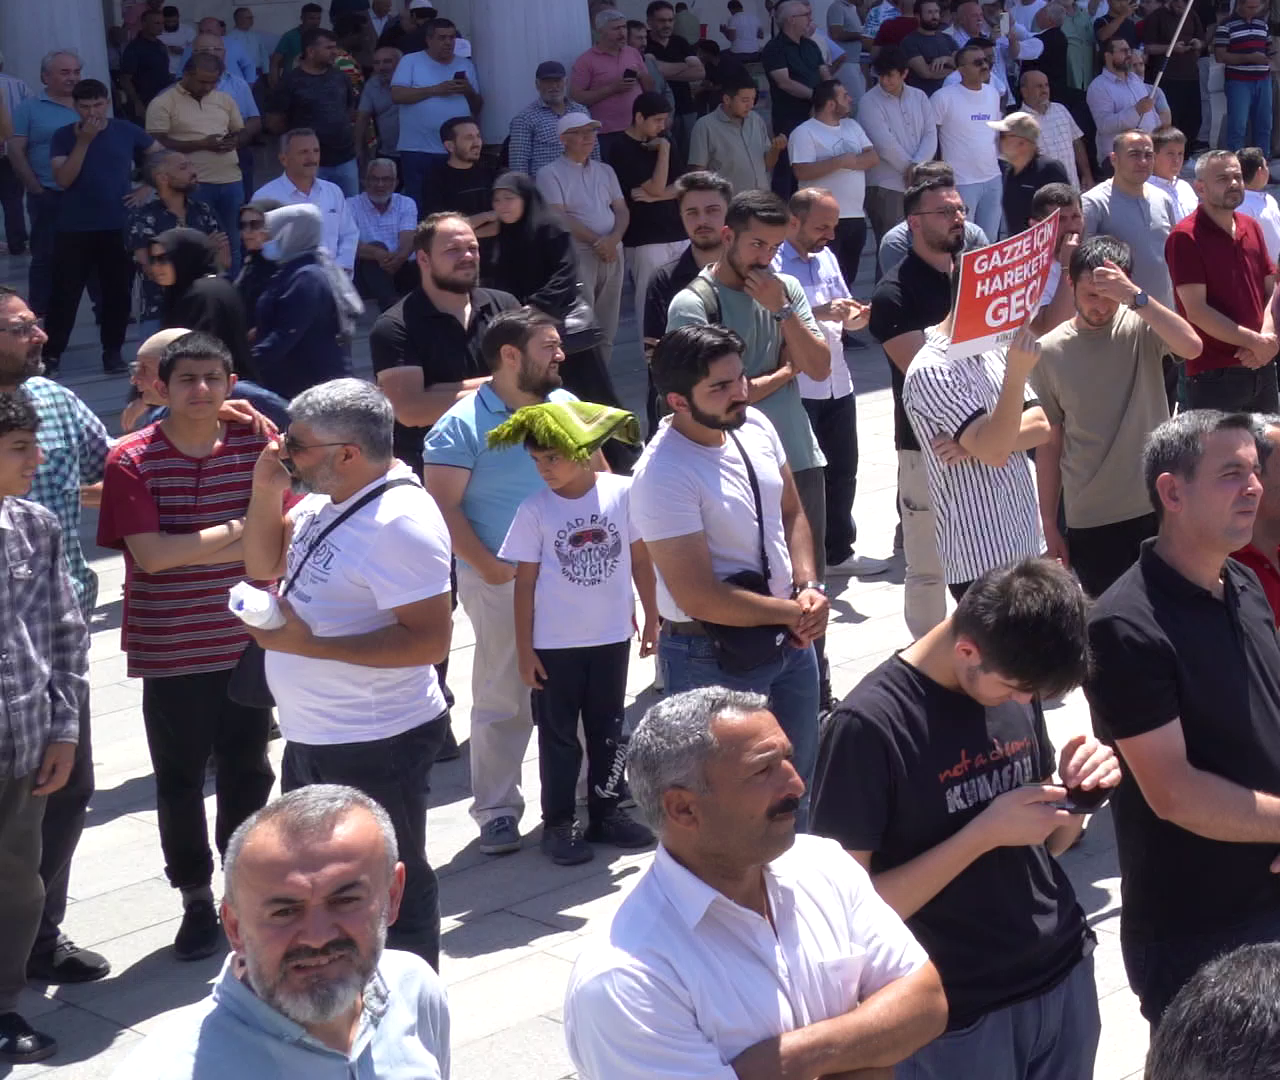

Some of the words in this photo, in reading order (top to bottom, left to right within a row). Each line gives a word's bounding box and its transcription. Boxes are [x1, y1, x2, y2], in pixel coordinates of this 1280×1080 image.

[974, 235, 1033, 275] GAZZE
[1033, 222, 1054, 250] İÇİN
[975, 252, 1049, 298] HAREKETE
[554, 518, 585, 548] ROAD
